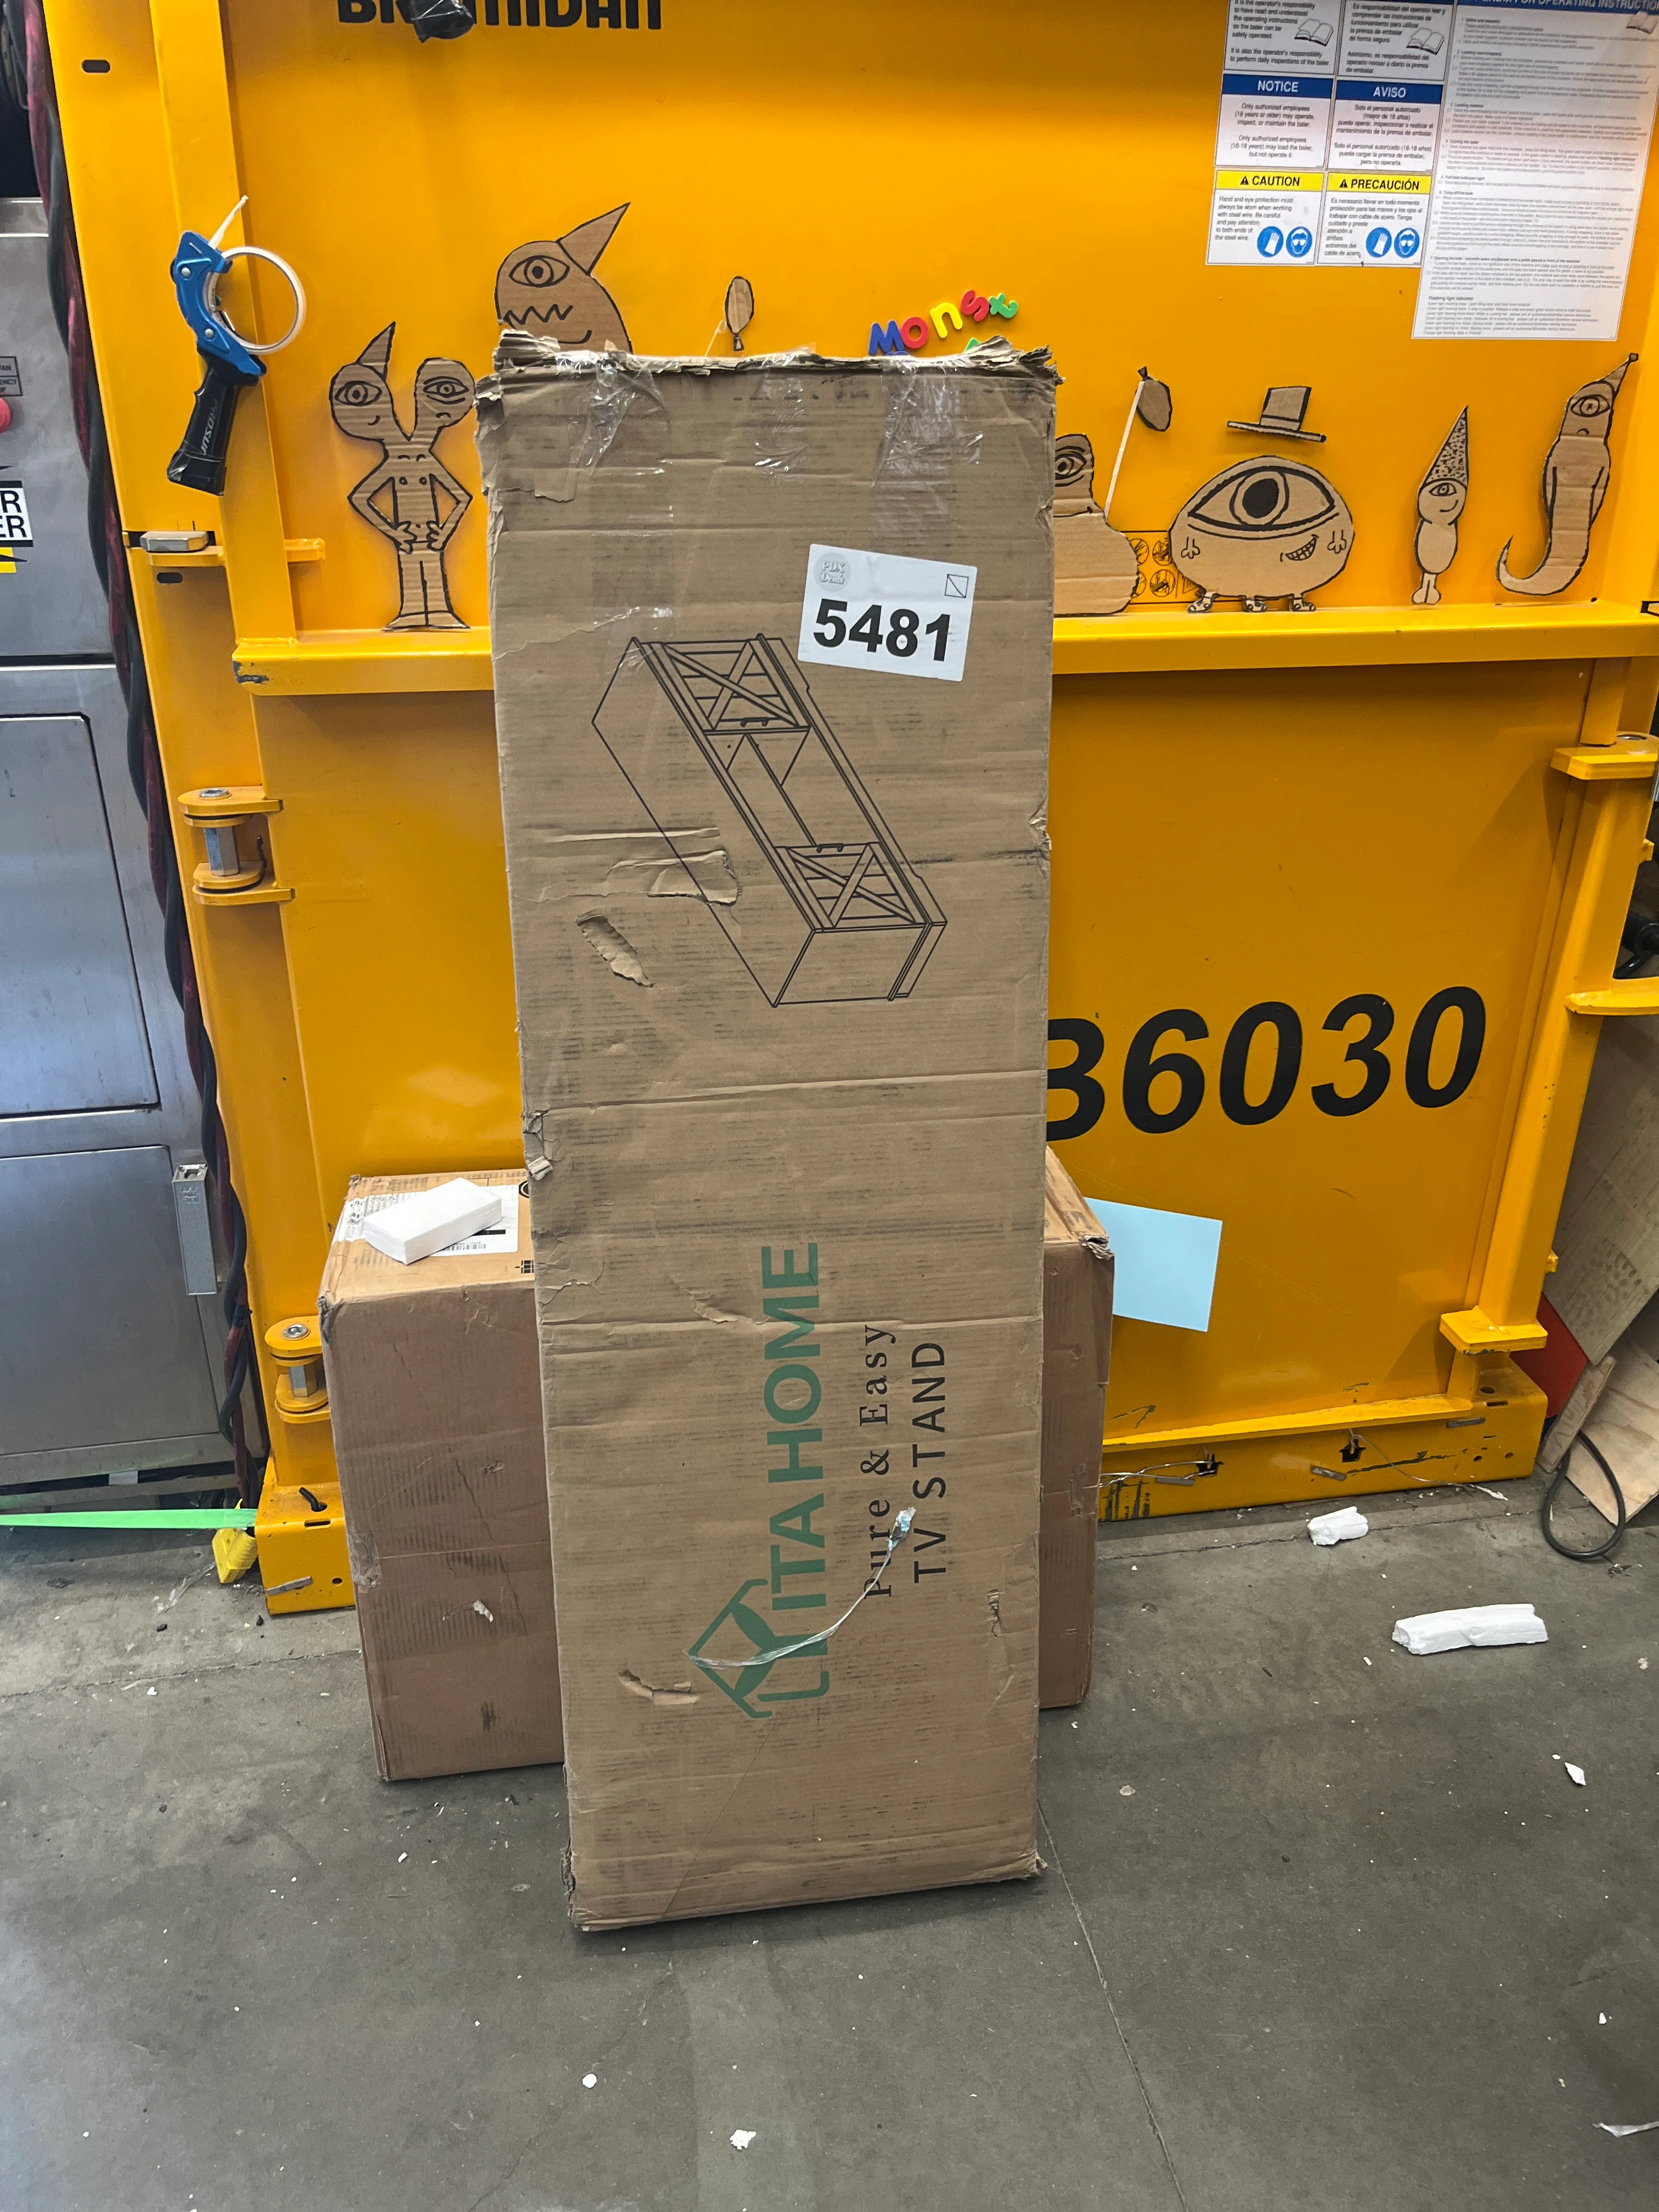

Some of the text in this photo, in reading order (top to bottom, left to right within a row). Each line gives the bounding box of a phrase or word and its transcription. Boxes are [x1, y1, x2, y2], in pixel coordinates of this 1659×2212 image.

[337, 0, 661, 30] BRMIDAN
[1257, 80, 1299, 93] NOTICE
[1373, 86, 1407, 98] AVISO
[1252, 176, 1300, 187] CAUTION
[1351, 178, 1420, 190] PRECAUCIÓN
[821, 561, 845, 573] PDX
[819, 572, 845, 584] Deals
[813, 599, 950, 662] 5481
[859, 1324, 896, 1599] Pure & Easy
[911, 1342, 946, 1583] TV STAND
